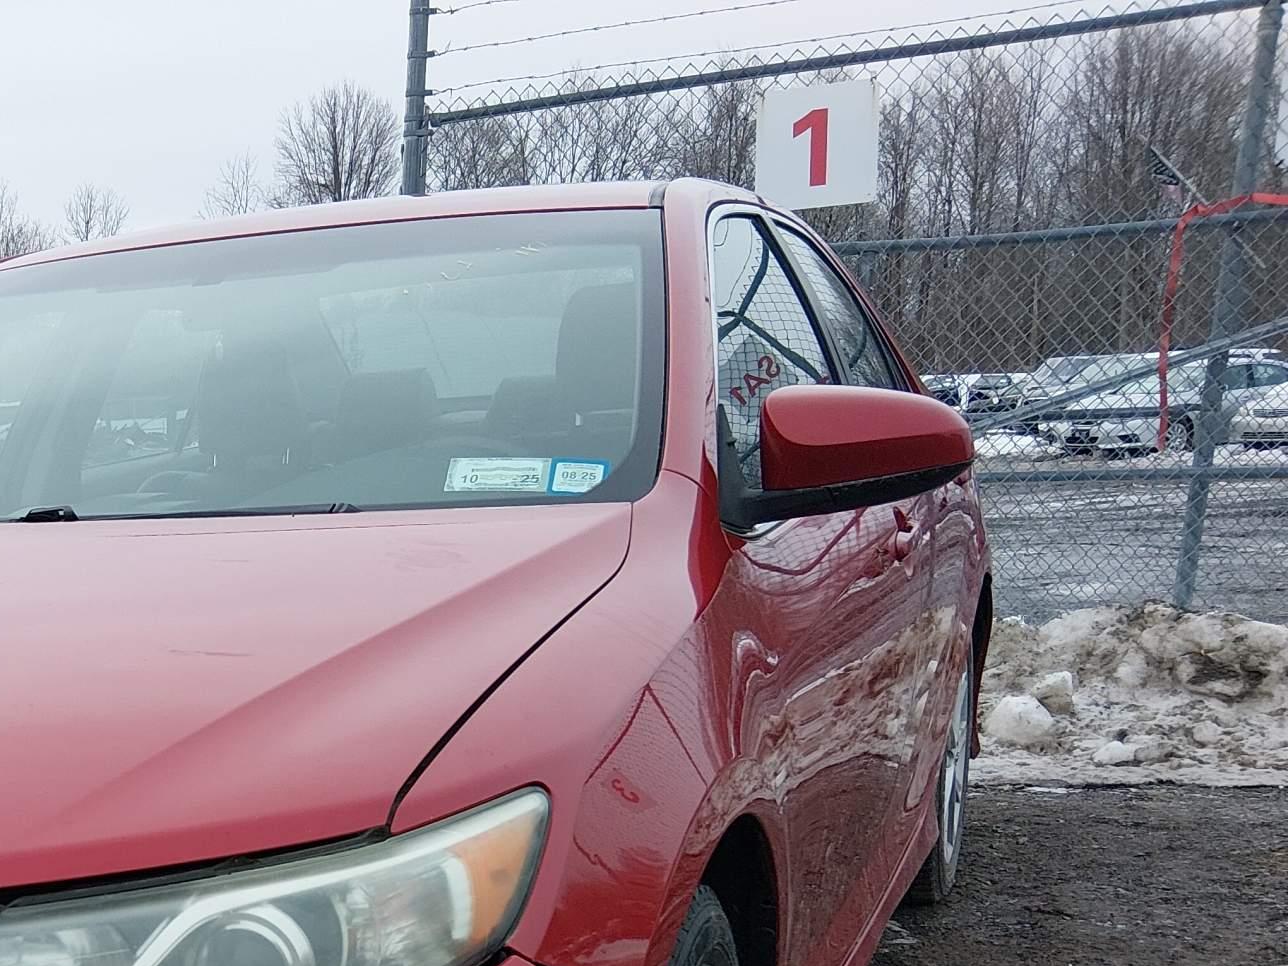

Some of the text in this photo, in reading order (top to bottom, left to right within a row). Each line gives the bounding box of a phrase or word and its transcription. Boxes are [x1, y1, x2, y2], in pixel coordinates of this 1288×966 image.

[792, 107, 829, 187] 1
[460, 473, 540, 484] 10 25
[561, 471, 598, 481] 08 25
